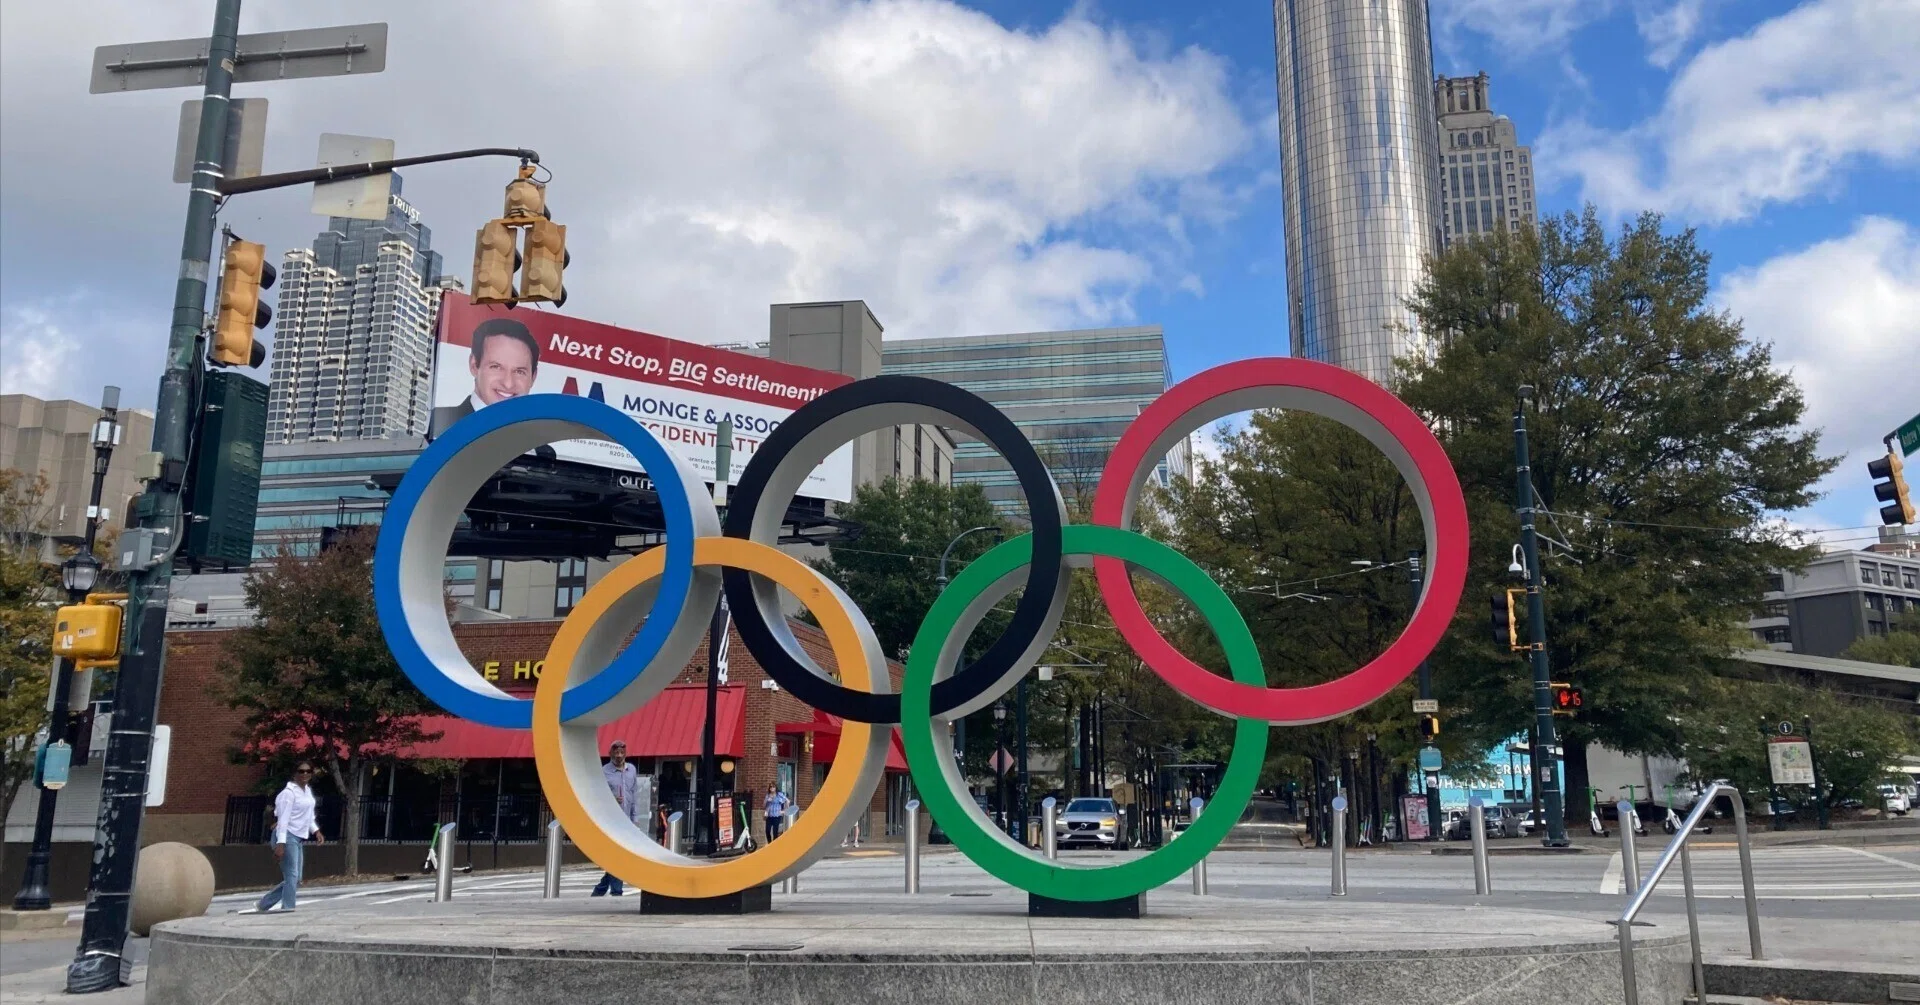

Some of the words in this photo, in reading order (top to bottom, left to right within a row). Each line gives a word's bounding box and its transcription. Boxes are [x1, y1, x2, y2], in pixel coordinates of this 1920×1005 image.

[392, 194, 420, 221] TRUIST
[549, 333, 603, 360] Next
[608, 347, 663, 375] Stop,
[668, 358, 708, 381] BIG
[623, 394, 699, 422] MONGE
[704, 409, 717, 425] &
